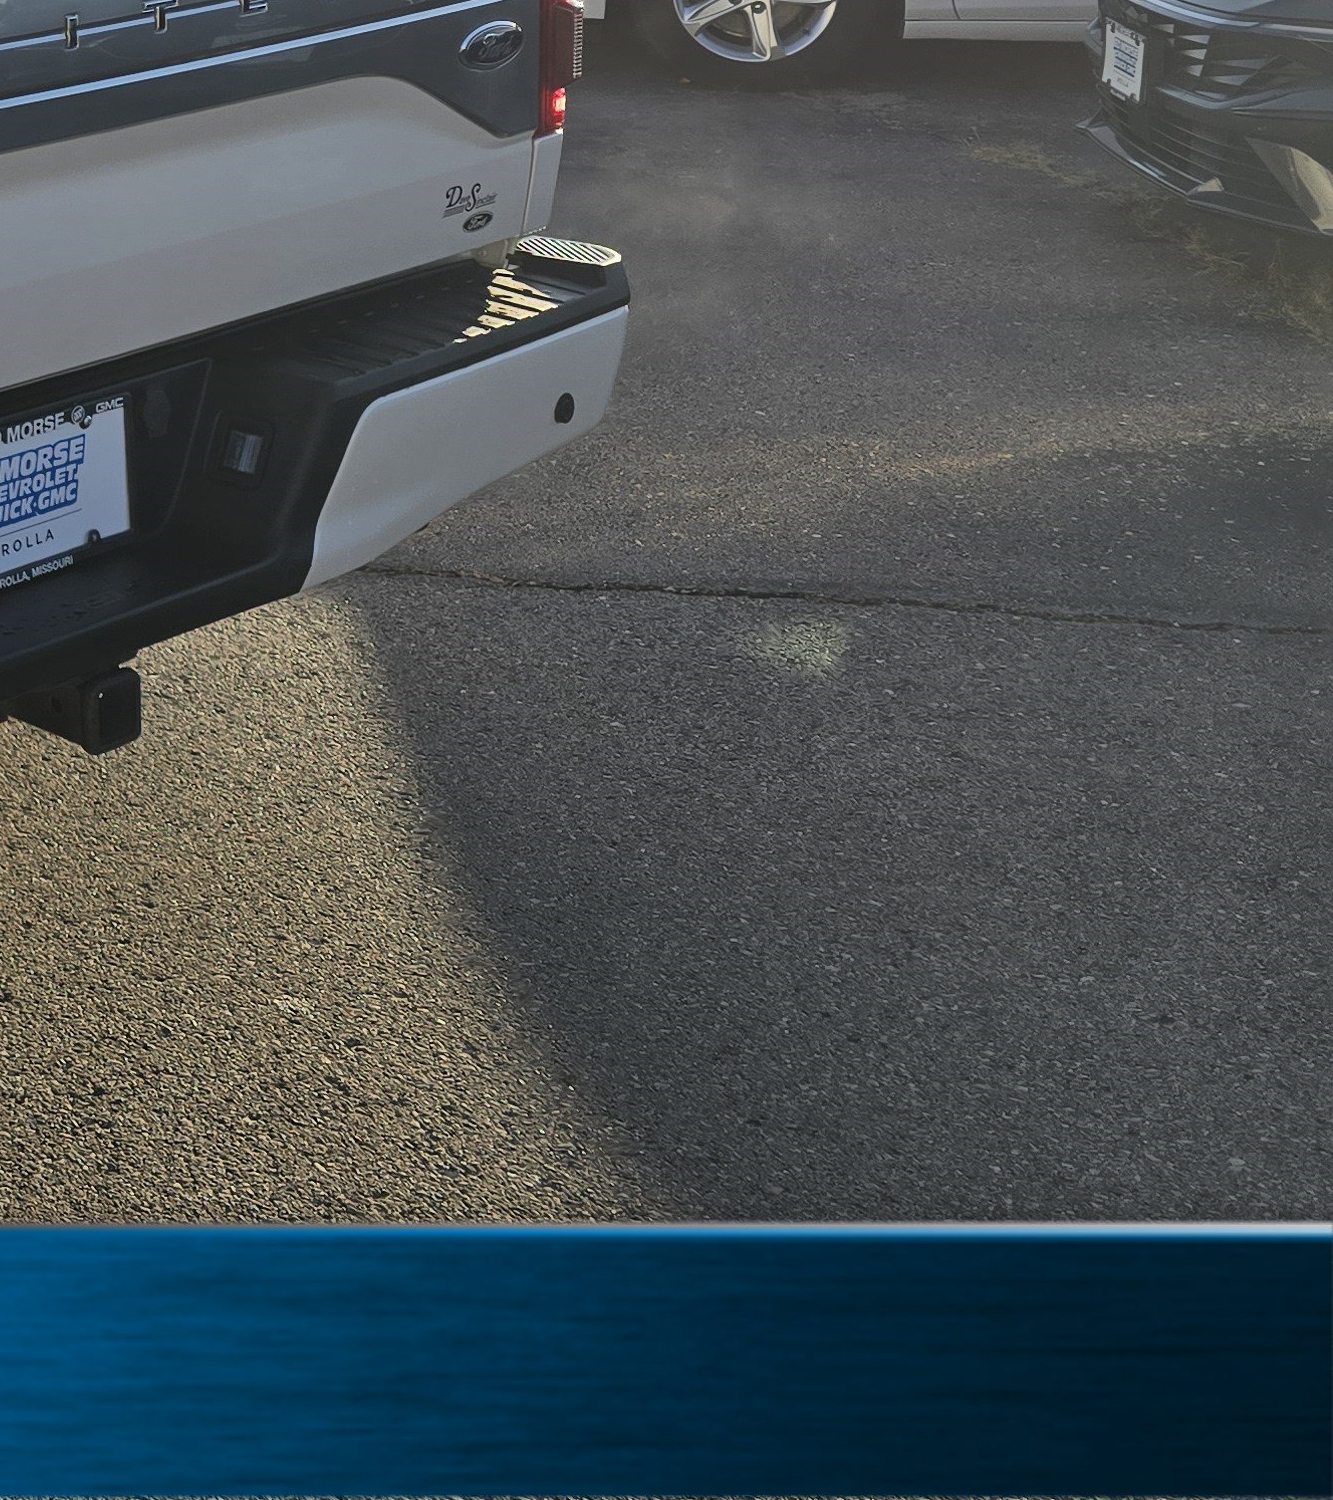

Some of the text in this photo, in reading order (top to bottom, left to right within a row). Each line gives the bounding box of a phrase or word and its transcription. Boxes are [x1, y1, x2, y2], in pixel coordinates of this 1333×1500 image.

[5, 412, 66, 444] MORSE
[95, 397, 124, 414] GMC
[0, 528, 55, 557] ROLLA
[31, 554, 74, 578] MISSOURI
